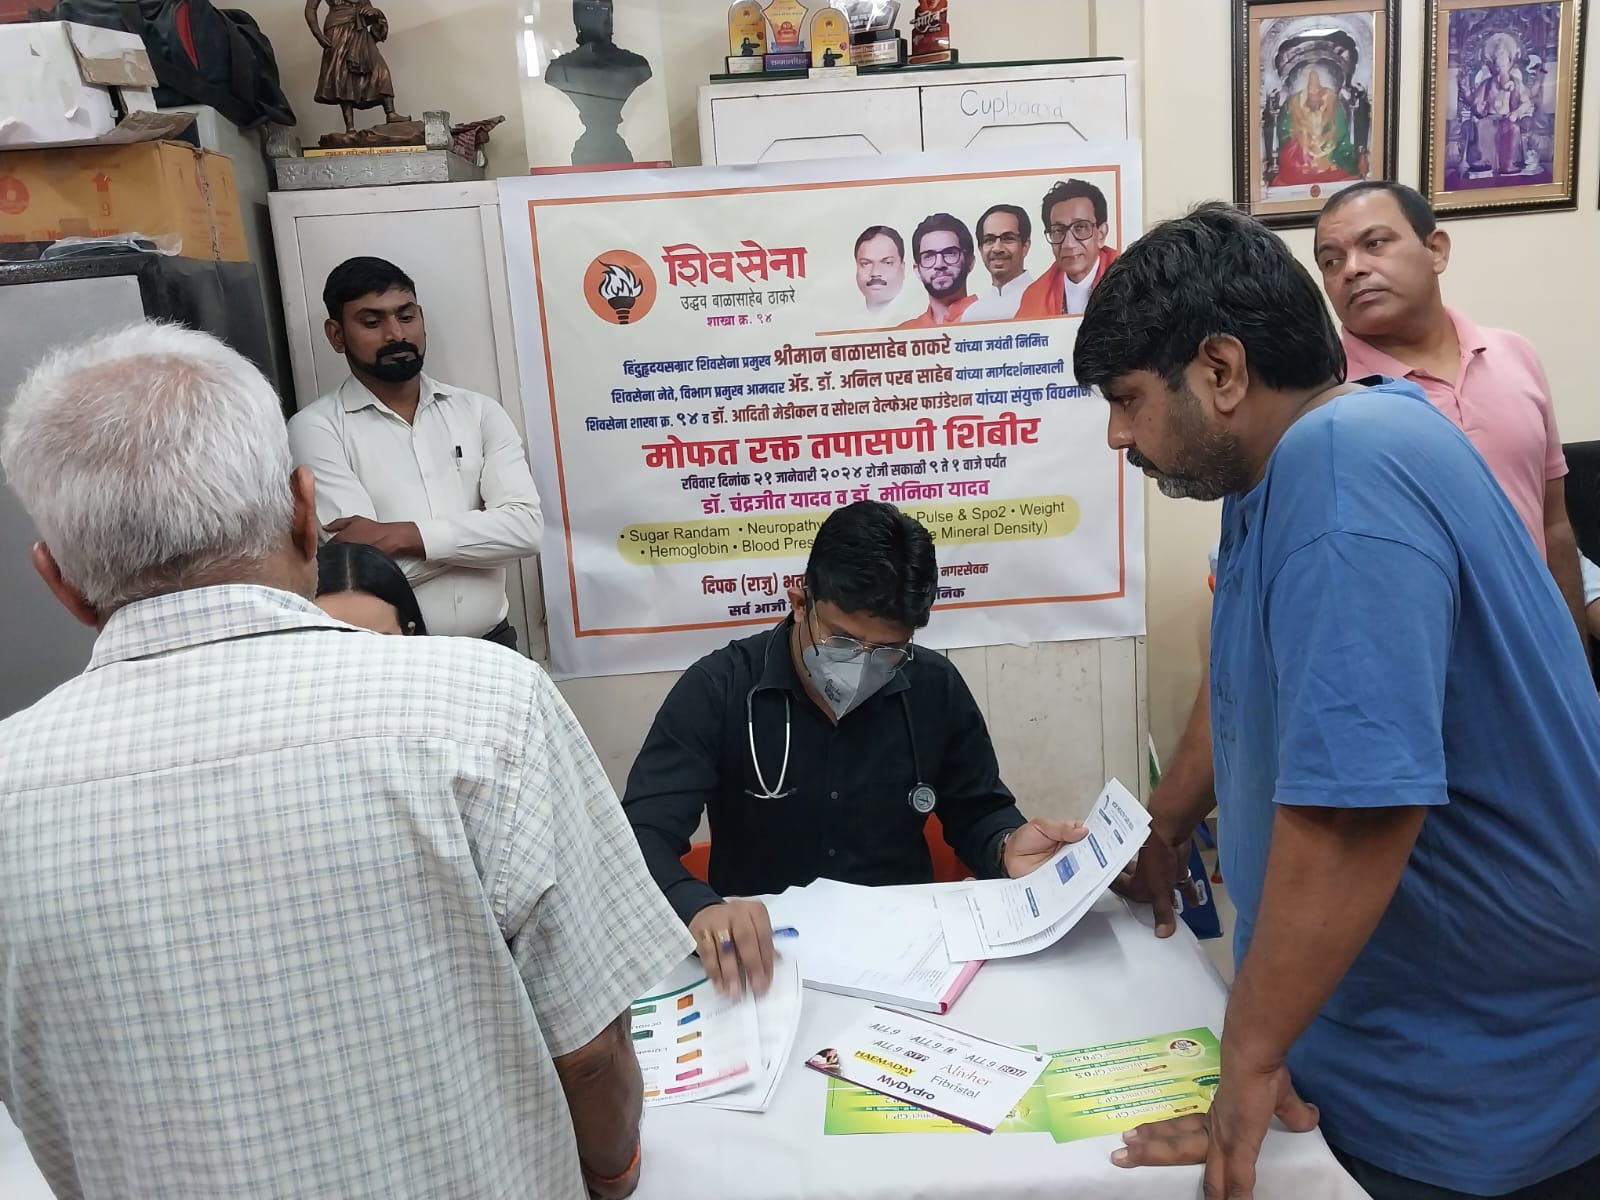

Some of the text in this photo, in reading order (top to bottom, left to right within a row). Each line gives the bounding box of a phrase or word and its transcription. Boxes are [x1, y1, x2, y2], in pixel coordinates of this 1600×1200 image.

[661, 240, 808, 288] शिवसेना
[680, 284, 796, 311] उद्धव बाळासाहेब ठाकरे
[706, 313, 772, 328] शाखा क्र. ९४
[696, 355, 740, 371] शिवसेना
[742, 355, 771, 372] प्रमुख
[774, 343, 827, 366] श्रीमान
[830, 337, 907, 363] बाळासाहेब
[910, 333, 951, 356] ठाकरे
[954, 339, 983, 353] यांच्या
[985, 335, 1013, 351] जयंती
[1015, 333, 1049, 349] निमित्त
[611, 387, 655, 403] शिवसेना
[656, 386, 678, 402] नेते,
[680, 385, 712, 400] विभाग
[713, 384, 744, 401] प्रमुख
[746, 382, 785, 396] आमदार
[817, 371, 836, 391] डॉ.
[840, 369, 883, 389] अनिल
[885, 369, 914, 386] परब
[916, 364, 954, 384] साहेब
[955, 366, 983, 380] यांच्या
[986, 358, 1064, 378] मार्गदर्शनाखाली
[585, 416, 628, 431] शिवसेना
[630, 416, 658, 429] शाखा
[659, 415, 674, 428] क्र.
[676, 412, 698, 426] ९४
[702, 413, 710, 424] व
[711, 406, 728, 425] डॉ.
[731, 403, 770, 423] आदिती
[772, 401, 818, 420] मेडीकल
[820, 403, 829, 417] व
[832, 399, 870, 417] सोशल
[872, 395, 918, 413] वेल्फेअर
[920, 391, 973, 410] फाउंडेशन
[975, 388, 1008, 405] यांच्या
[1010, 386, 1044, 407] संयुक्त
[641, 412, 1041, 469] मोफत रक्त तपासणी शिबीर
[681, 474, 716, 490] रविवार
[717, 472, 751, 488] दिनांक
[754, 472, 772, 486] २१
[775, 466, 817, 484] जानेवारी
[820, 466, 863, 482] २०२४
[865, 462, 889, 478] रोजी
[891, 459, 927, 476] सकाळी
[929, 460, 938, 473] ९
[941, 458, 949, 472] ते
[952, 459, 960, 472] १
[962, 455, 983, 471] वाजे
[701, 493, 725, 514] डॉ.
[729, 489, 786, 513] चंद्रजीत
[789, 491, 832, 509] यादव
[835, 489, 848, 506] व
[878, 480, 945, 502] मोनिका
[946, 480, 990, 497] यादव
[629, 529, 669, 544] Sugar
[674, 525, 730, 540] Randam
[916, 510, 952, 524] Pulse
[958, 509, 968, 521] &
[972, 506, 1006, 522] Spo2
[1019, 501, 1065, 517] Weight
[650, 542, 729, 558] Hemoglobin
[742, 539, 779, 553] Blood
[784, 537, 815, 550] Pres
[941, 524, 989, 539] Mineral
[994, 520, 1048, 537] Density)
[701, 575, 738, 595] दिपक
[940, 561, 989, 577] नगरसेवक
[728, 601, 751, 616] सर्व
[755, 598, 787, 614] आजी
[877, 1074, 935, 1100] MyDydro
[930, 1075, 981, 1099] Fibristal
